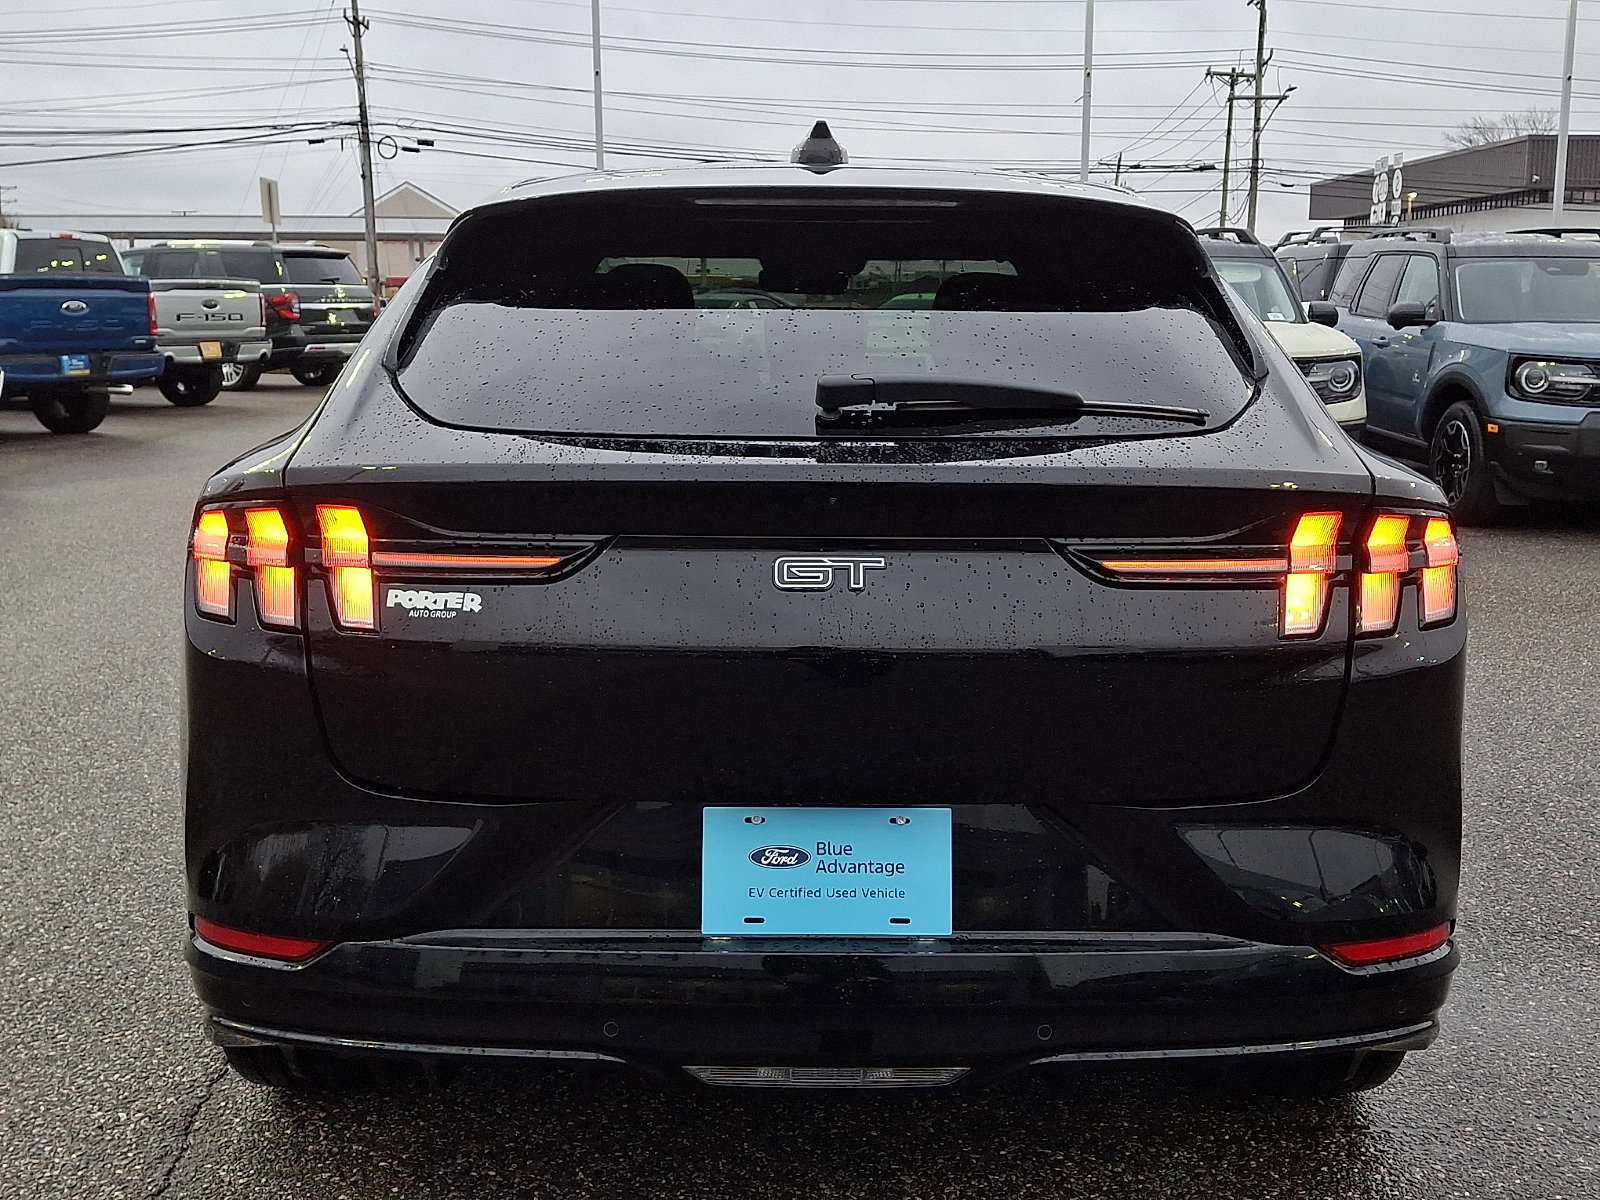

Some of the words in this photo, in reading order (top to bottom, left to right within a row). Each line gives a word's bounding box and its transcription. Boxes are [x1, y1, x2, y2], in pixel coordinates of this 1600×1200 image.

[176, 312, 244, 322] F-150
[774, 556, 887, 590] GT
[386, 589, 482, 613] PORTER
[408, 609, 429, 618] AUTO
[430, 610, 457, 619] GROUP
[816, 841, 853, 856] Blue
[761, 849, 799, 865] Ford
[815, 858, 905, 877] Advantage
[748, 887, 765, 898] EV
[768, 887, 821, 898] Certified
[826, 887, 857, 898] Used
[861, 887, 906, 899] Vehicle
